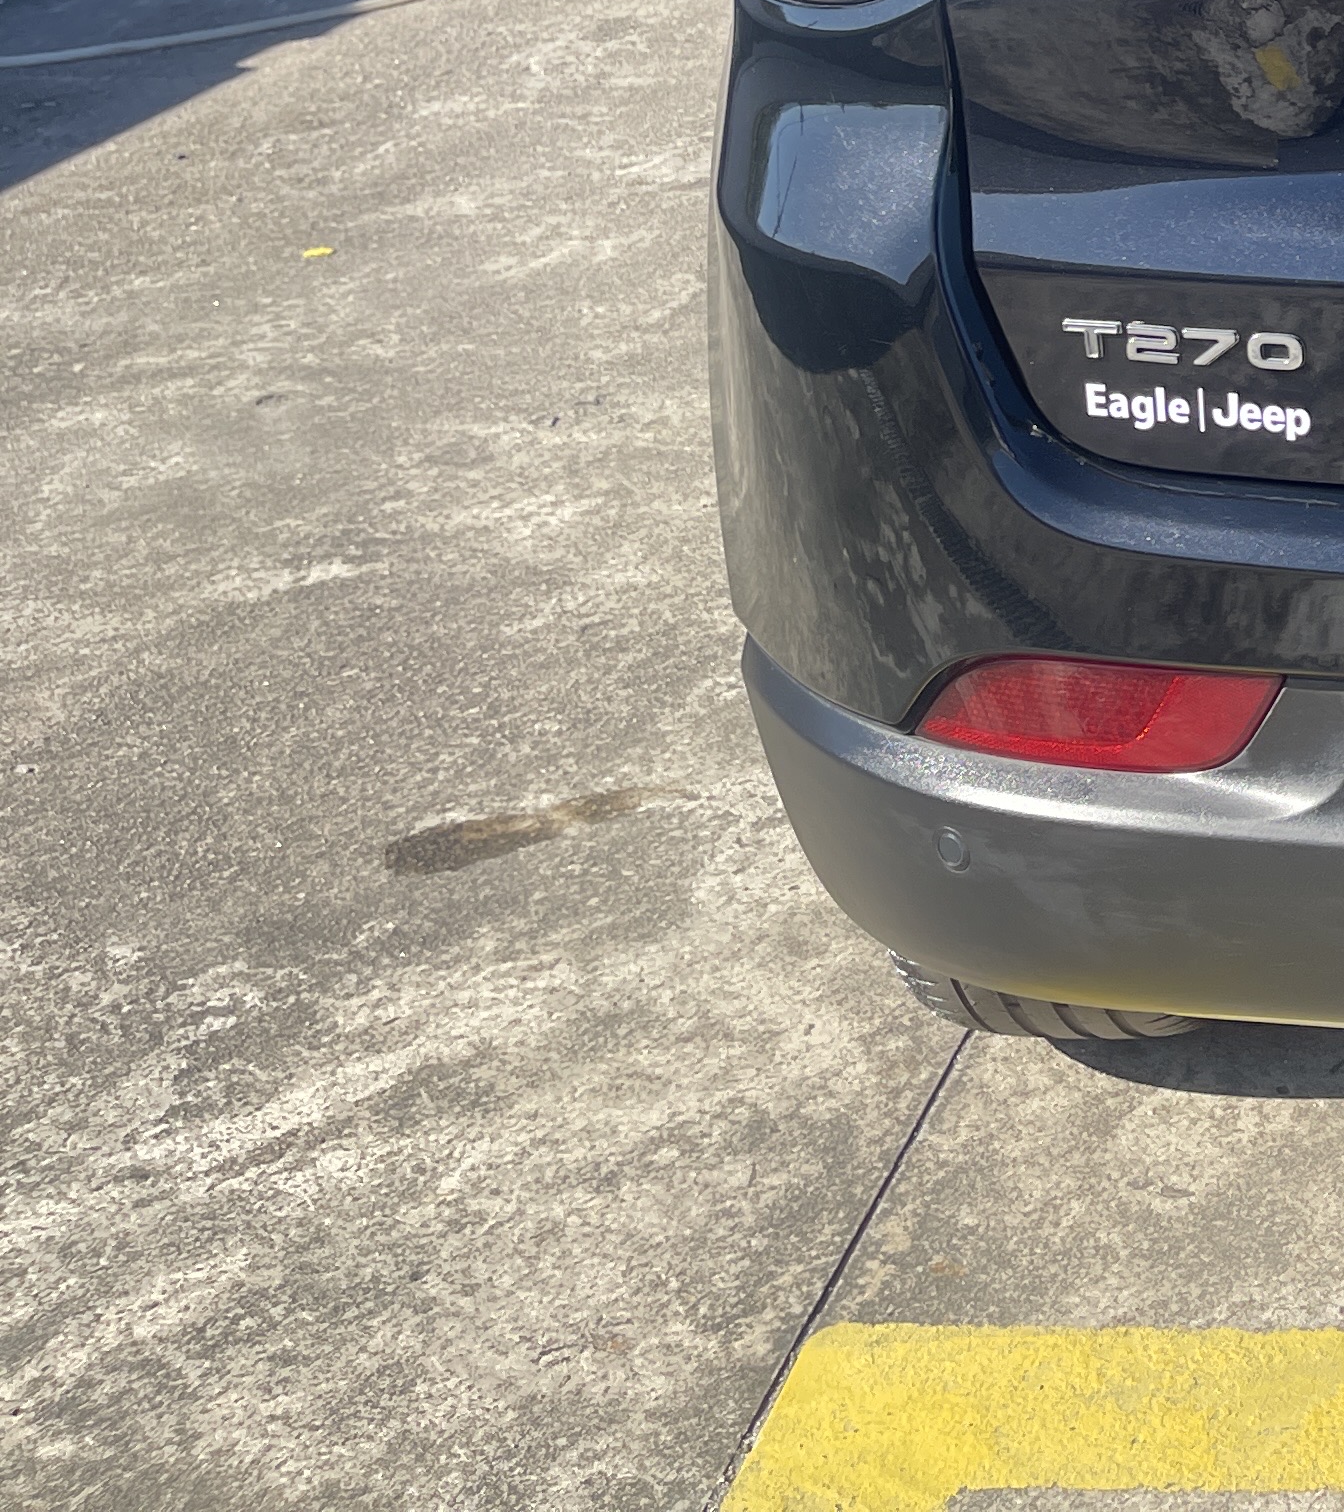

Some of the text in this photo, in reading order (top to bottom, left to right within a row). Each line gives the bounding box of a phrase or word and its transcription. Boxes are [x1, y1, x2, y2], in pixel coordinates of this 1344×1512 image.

[1061, 317, 1305, 371] T270
[1084, 383, 1311, 441] Eagle Jeep
